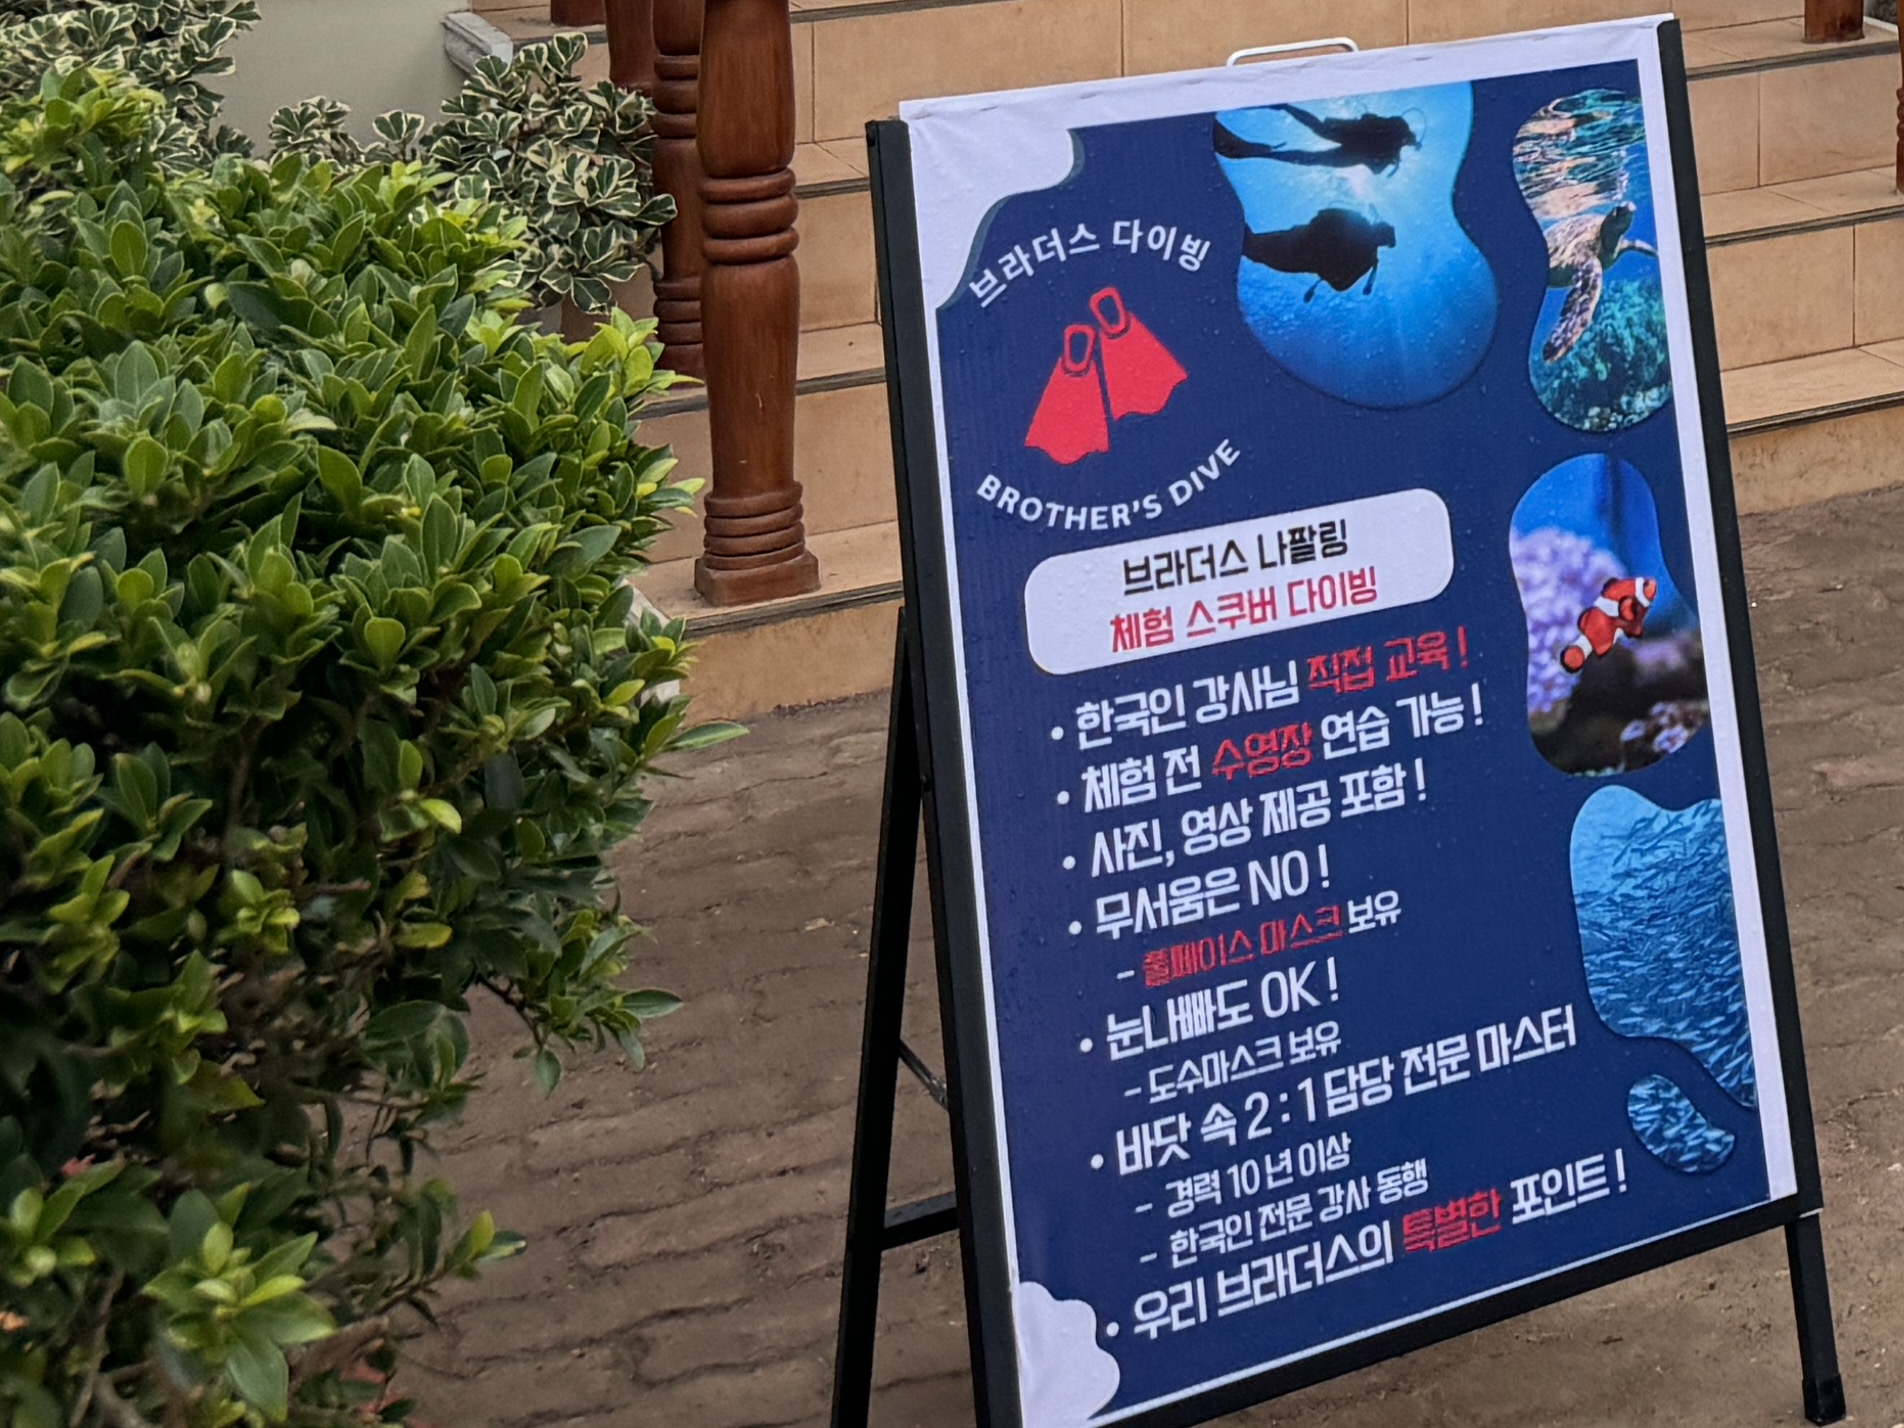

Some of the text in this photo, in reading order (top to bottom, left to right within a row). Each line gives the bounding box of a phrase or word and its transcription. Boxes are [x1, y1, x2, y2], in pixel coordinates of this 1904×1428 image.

[969, 219, 1211, 308] 브라더스 다이빙
[976, 438, 1241, 531] BROTHER'S DIVE
[1122, 519, 1348, 596] 브라더스 나팔링
[1110, 565, 1378, 654] 체험 스쿠버 다이빙
[1075, 684, 1187, 751] 한국인
[1192, 660, 1301, 724] 강사님
[1306, 645, 1377, 694] 직접
[1081, 754, 1157, 813] 체험
[1163, 745, 1202, 797] 전
[1211, 721, 1313, 781] 수영장
[1320, 705, 1391, 760] 연습
[1181, 797, 1253, 856] 영상
[1259, 779, 1332, 838] 제공
[1095, 866, 1241, 941] 무서움은
[1259, 904, 1344, 955] 마스크
[1347, 889, 1402, 935] 보유
[1115, 1112, 1192, 1175] 바닷
[1200, 1101, 1239, 1147] 속
[1401, 1032, 1471, 1096] 전문
[1476, 1003, 1577, 1073] 마스터
[1148, 1019, 1342, 1105] 도수마스크 보유
[1165, 1168, 1222, 1218] 경력
[1298, 1132, 1352, 1178] 이상
[1169, 1157, 1429, 1269] 한국인 전문 강사 동행
[1133, 1276, 1208, 1340] 우리
[1216, 1219, 1394, 1317] 브라더스의
[1401, 1187, 1503, 1254] 특별한
